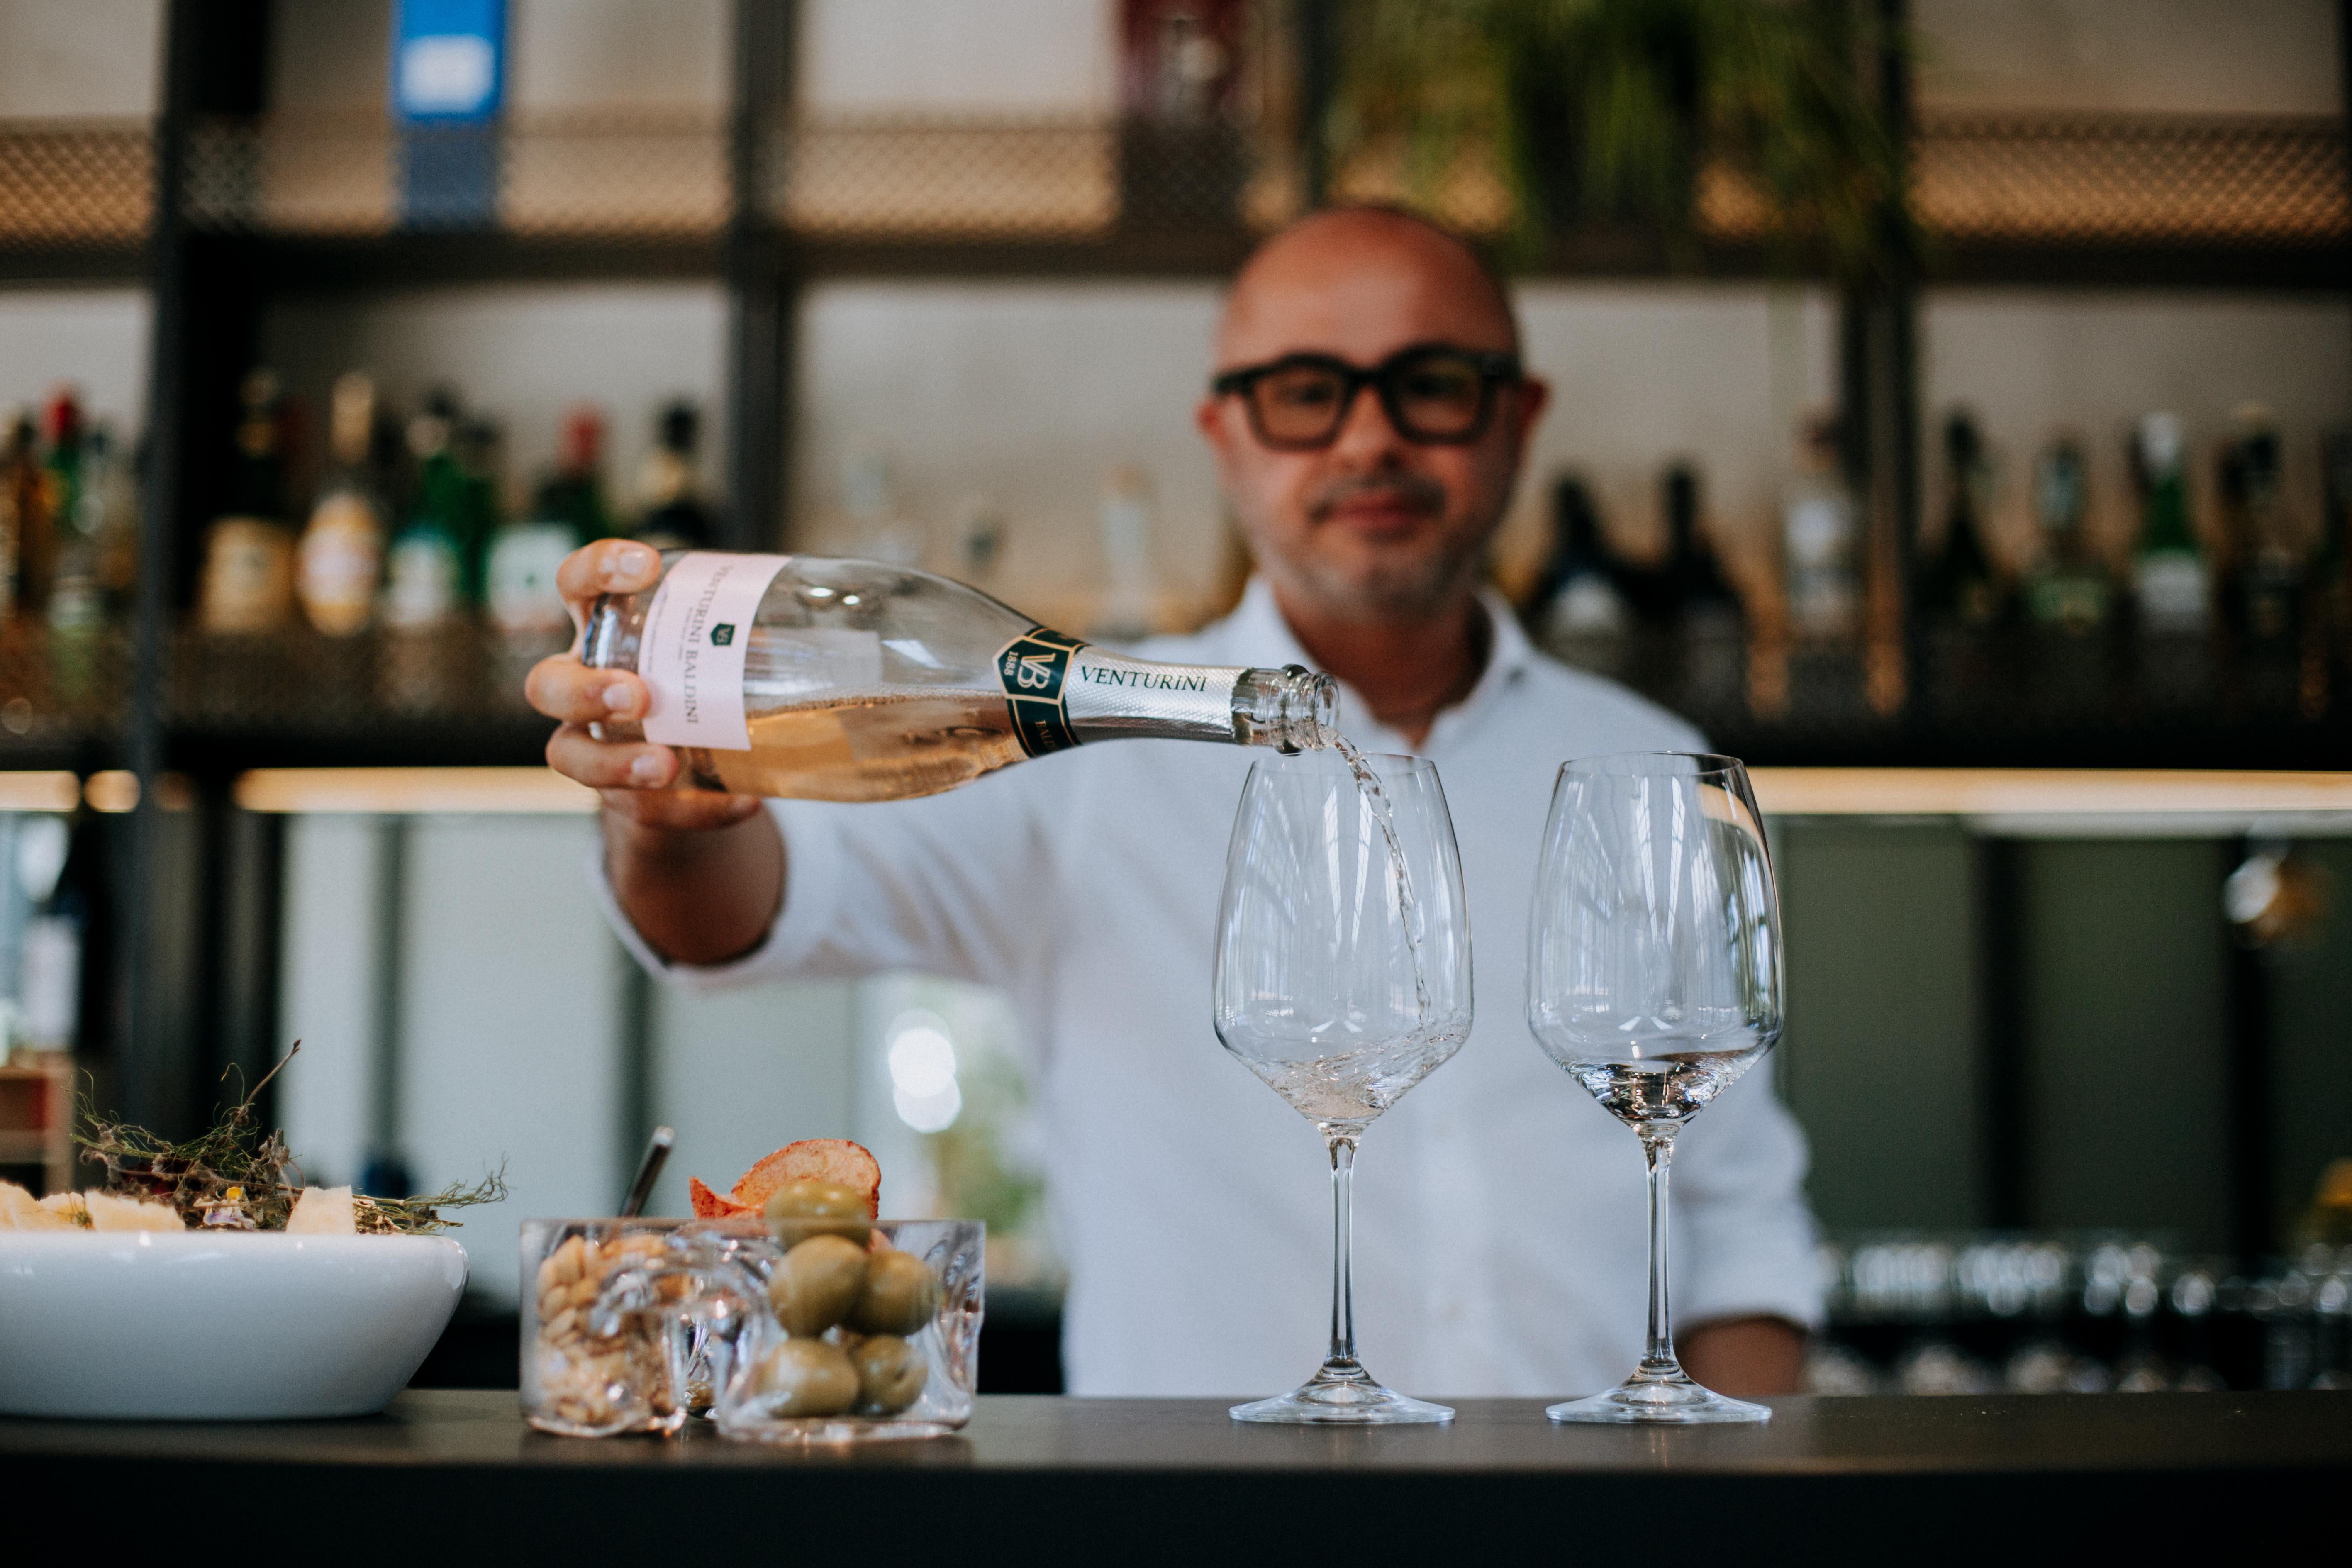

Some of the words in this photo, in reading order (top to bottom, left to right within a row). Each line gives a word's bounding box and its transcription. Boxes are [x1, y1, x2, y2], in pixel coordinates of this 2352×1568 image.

[686, 564, 734, 643] VENTURINI
[717, 627, 730, 644] VB
[1004, 651, 1018, 676] 1888
[1016, 652, 1056, 689] VB
[1080, 666, 1208, 692] VENTURINI
[684, 649, 699, 724] BALDINI
